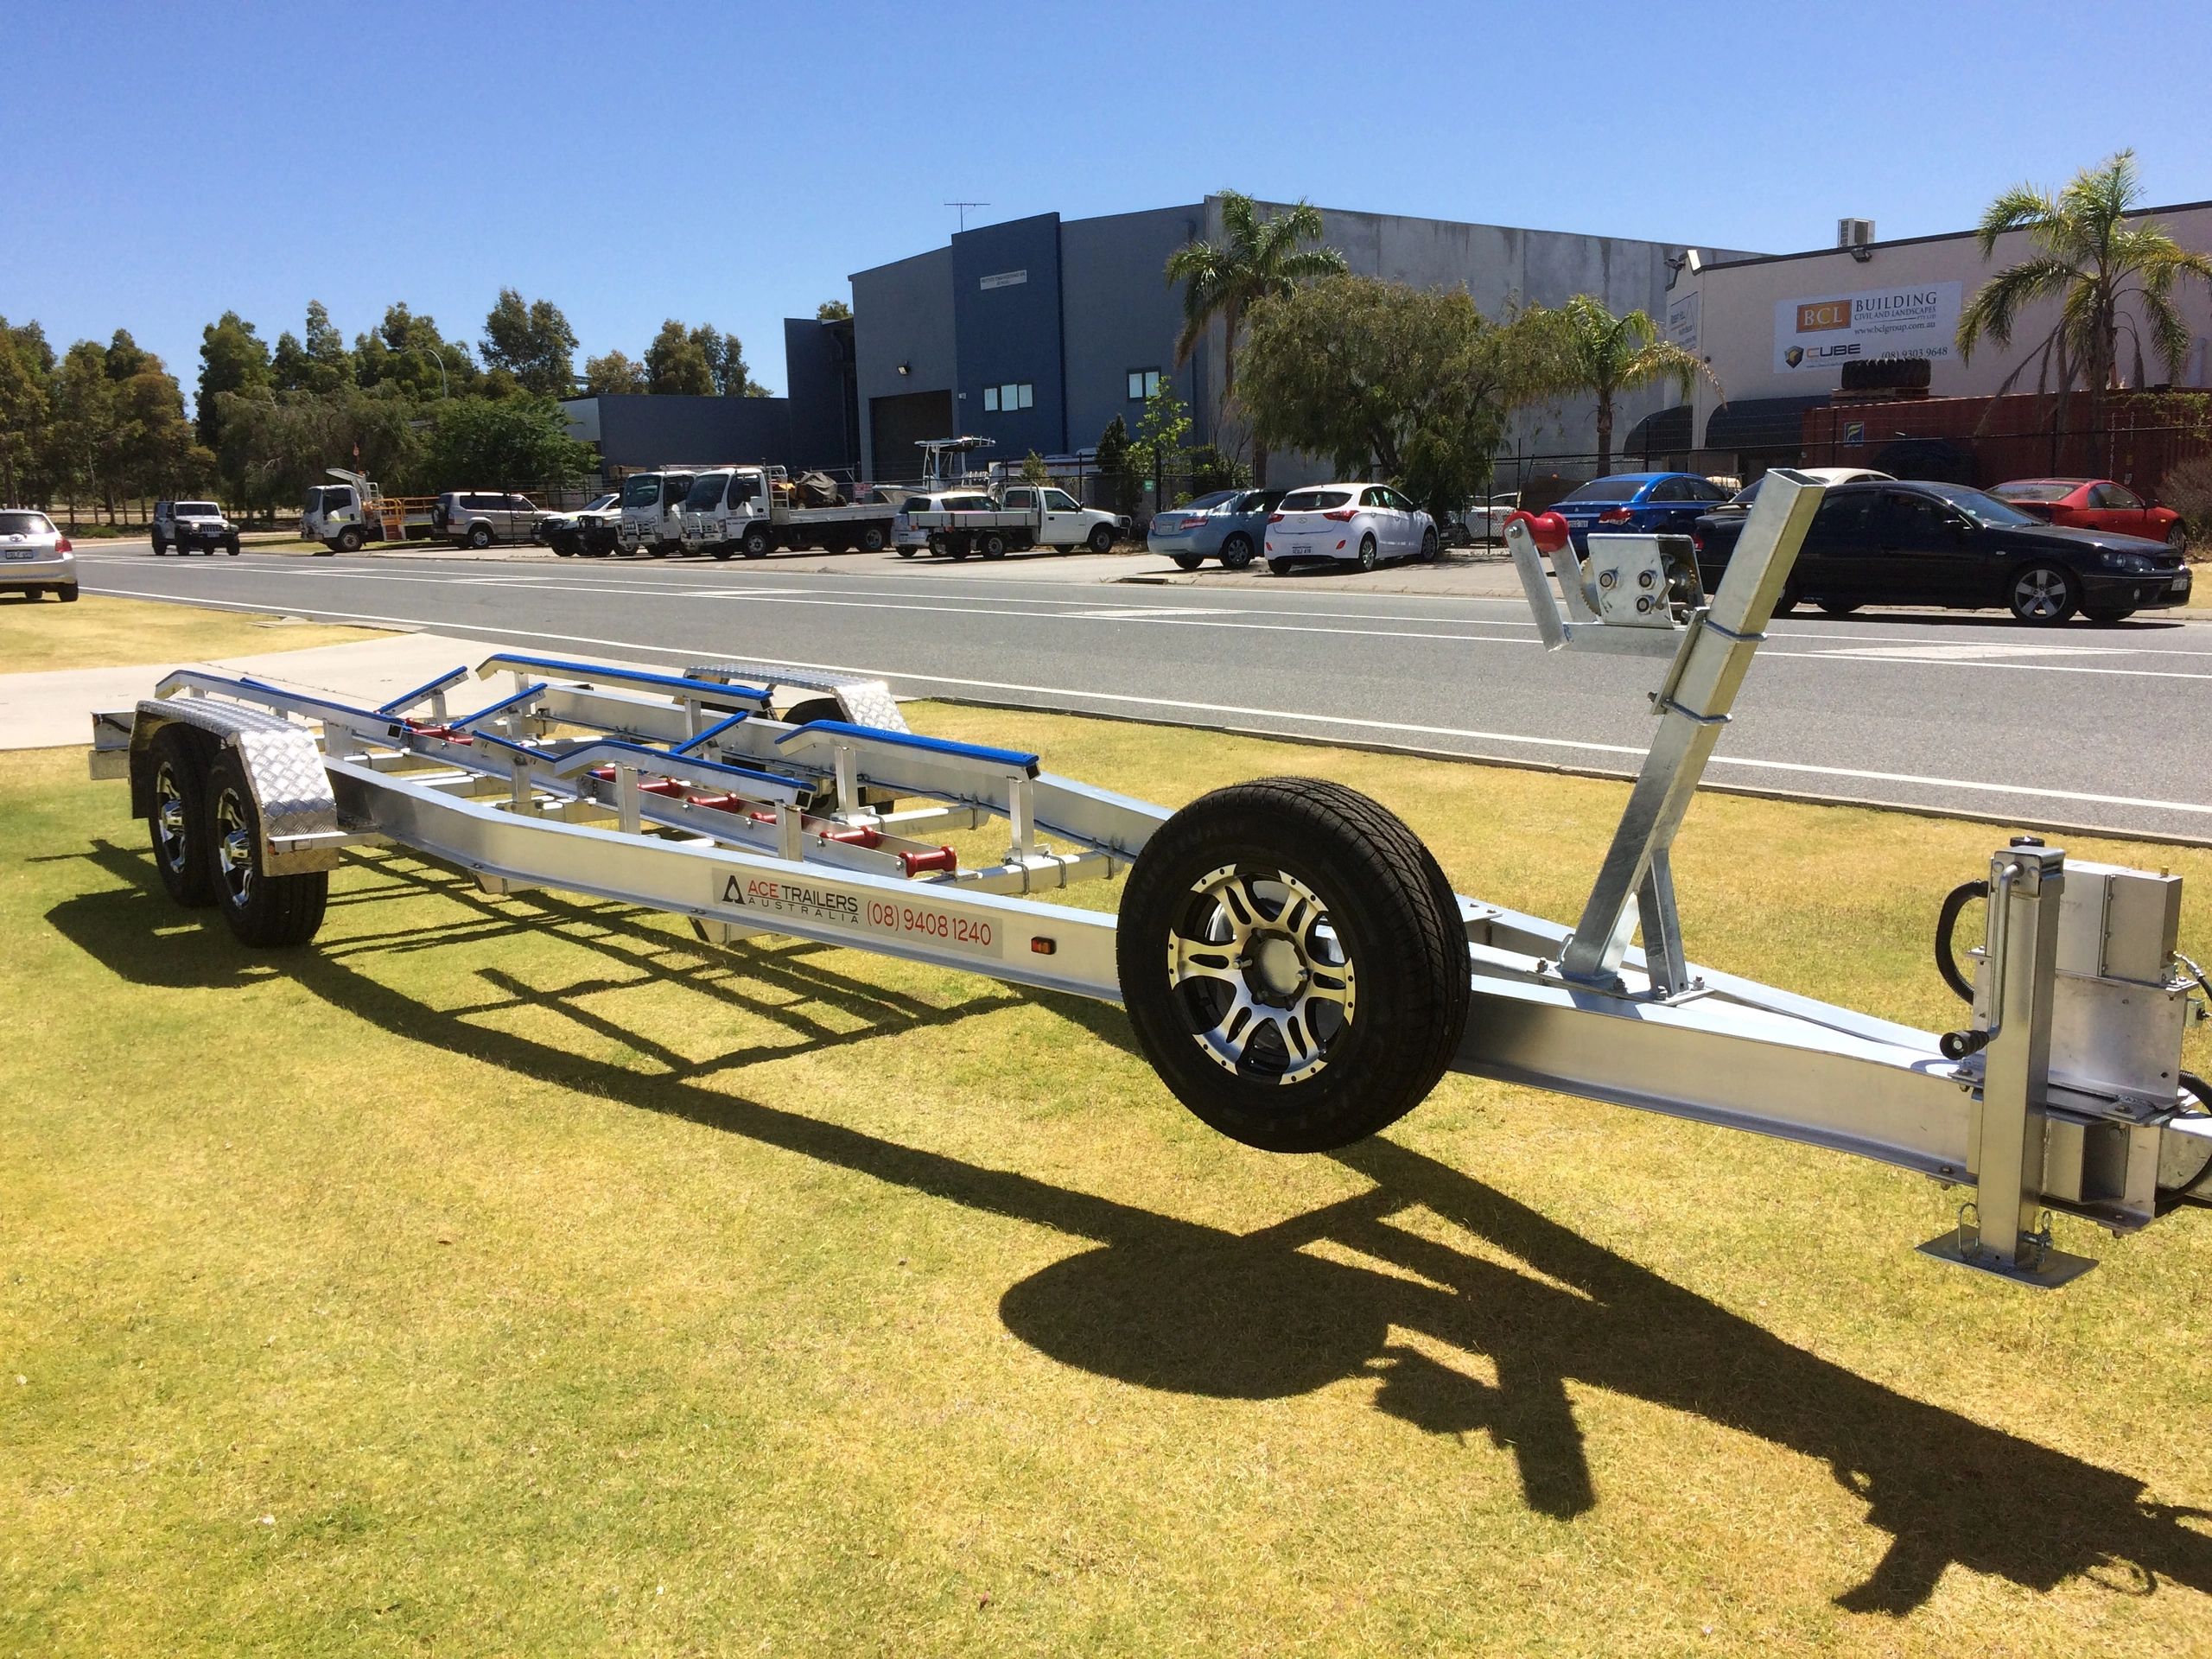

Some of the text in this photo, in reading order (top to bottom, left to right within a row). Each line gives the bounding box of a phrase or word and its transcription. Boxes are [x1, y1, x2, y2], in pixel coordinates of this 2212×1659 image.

[1856, 292, 1936, 312] BUILDING
[1804, 307, 1842, 326] BCL
[1854, 312, 1872, 321] CIVIL
[1891, 306, 1936, 317] LANDSCAPES
[1854, 321, 1936, 334] www.bclgroup.com.au
[1807, 344, 1860, 358] CUBE
[1902, 348, 1923, 359] 9303
[1926, 346, 1948, 356] 9648
[747, 880, 858, 912] ACE TRAILERS
[748, 897, 859, 924] AUSTRALIA
[867, 900, 991, 945] (08) 9408 1240
